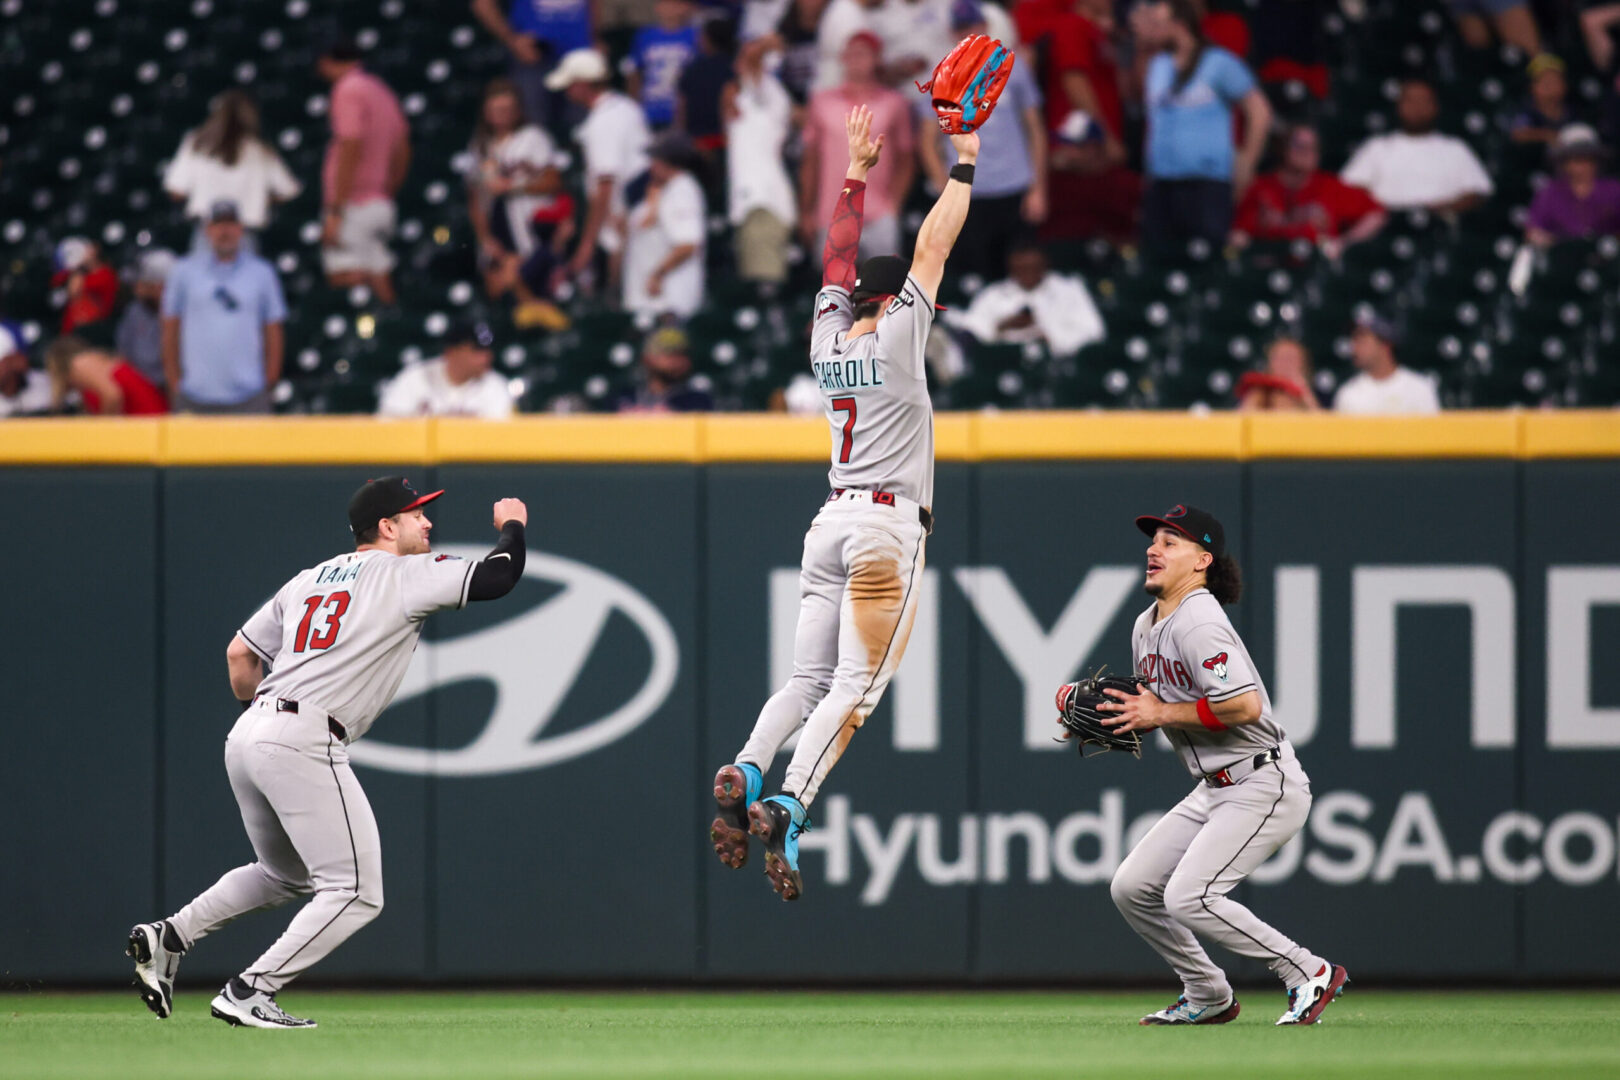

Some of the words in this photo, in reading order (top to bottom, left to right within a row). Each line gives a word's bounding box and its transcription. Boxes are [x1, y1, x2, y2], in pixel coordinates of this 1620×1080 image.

[814, 359, 883, 389] CARROLL
[831, 396, 858, 464] 7
[293, 590, 351, 653] 13
